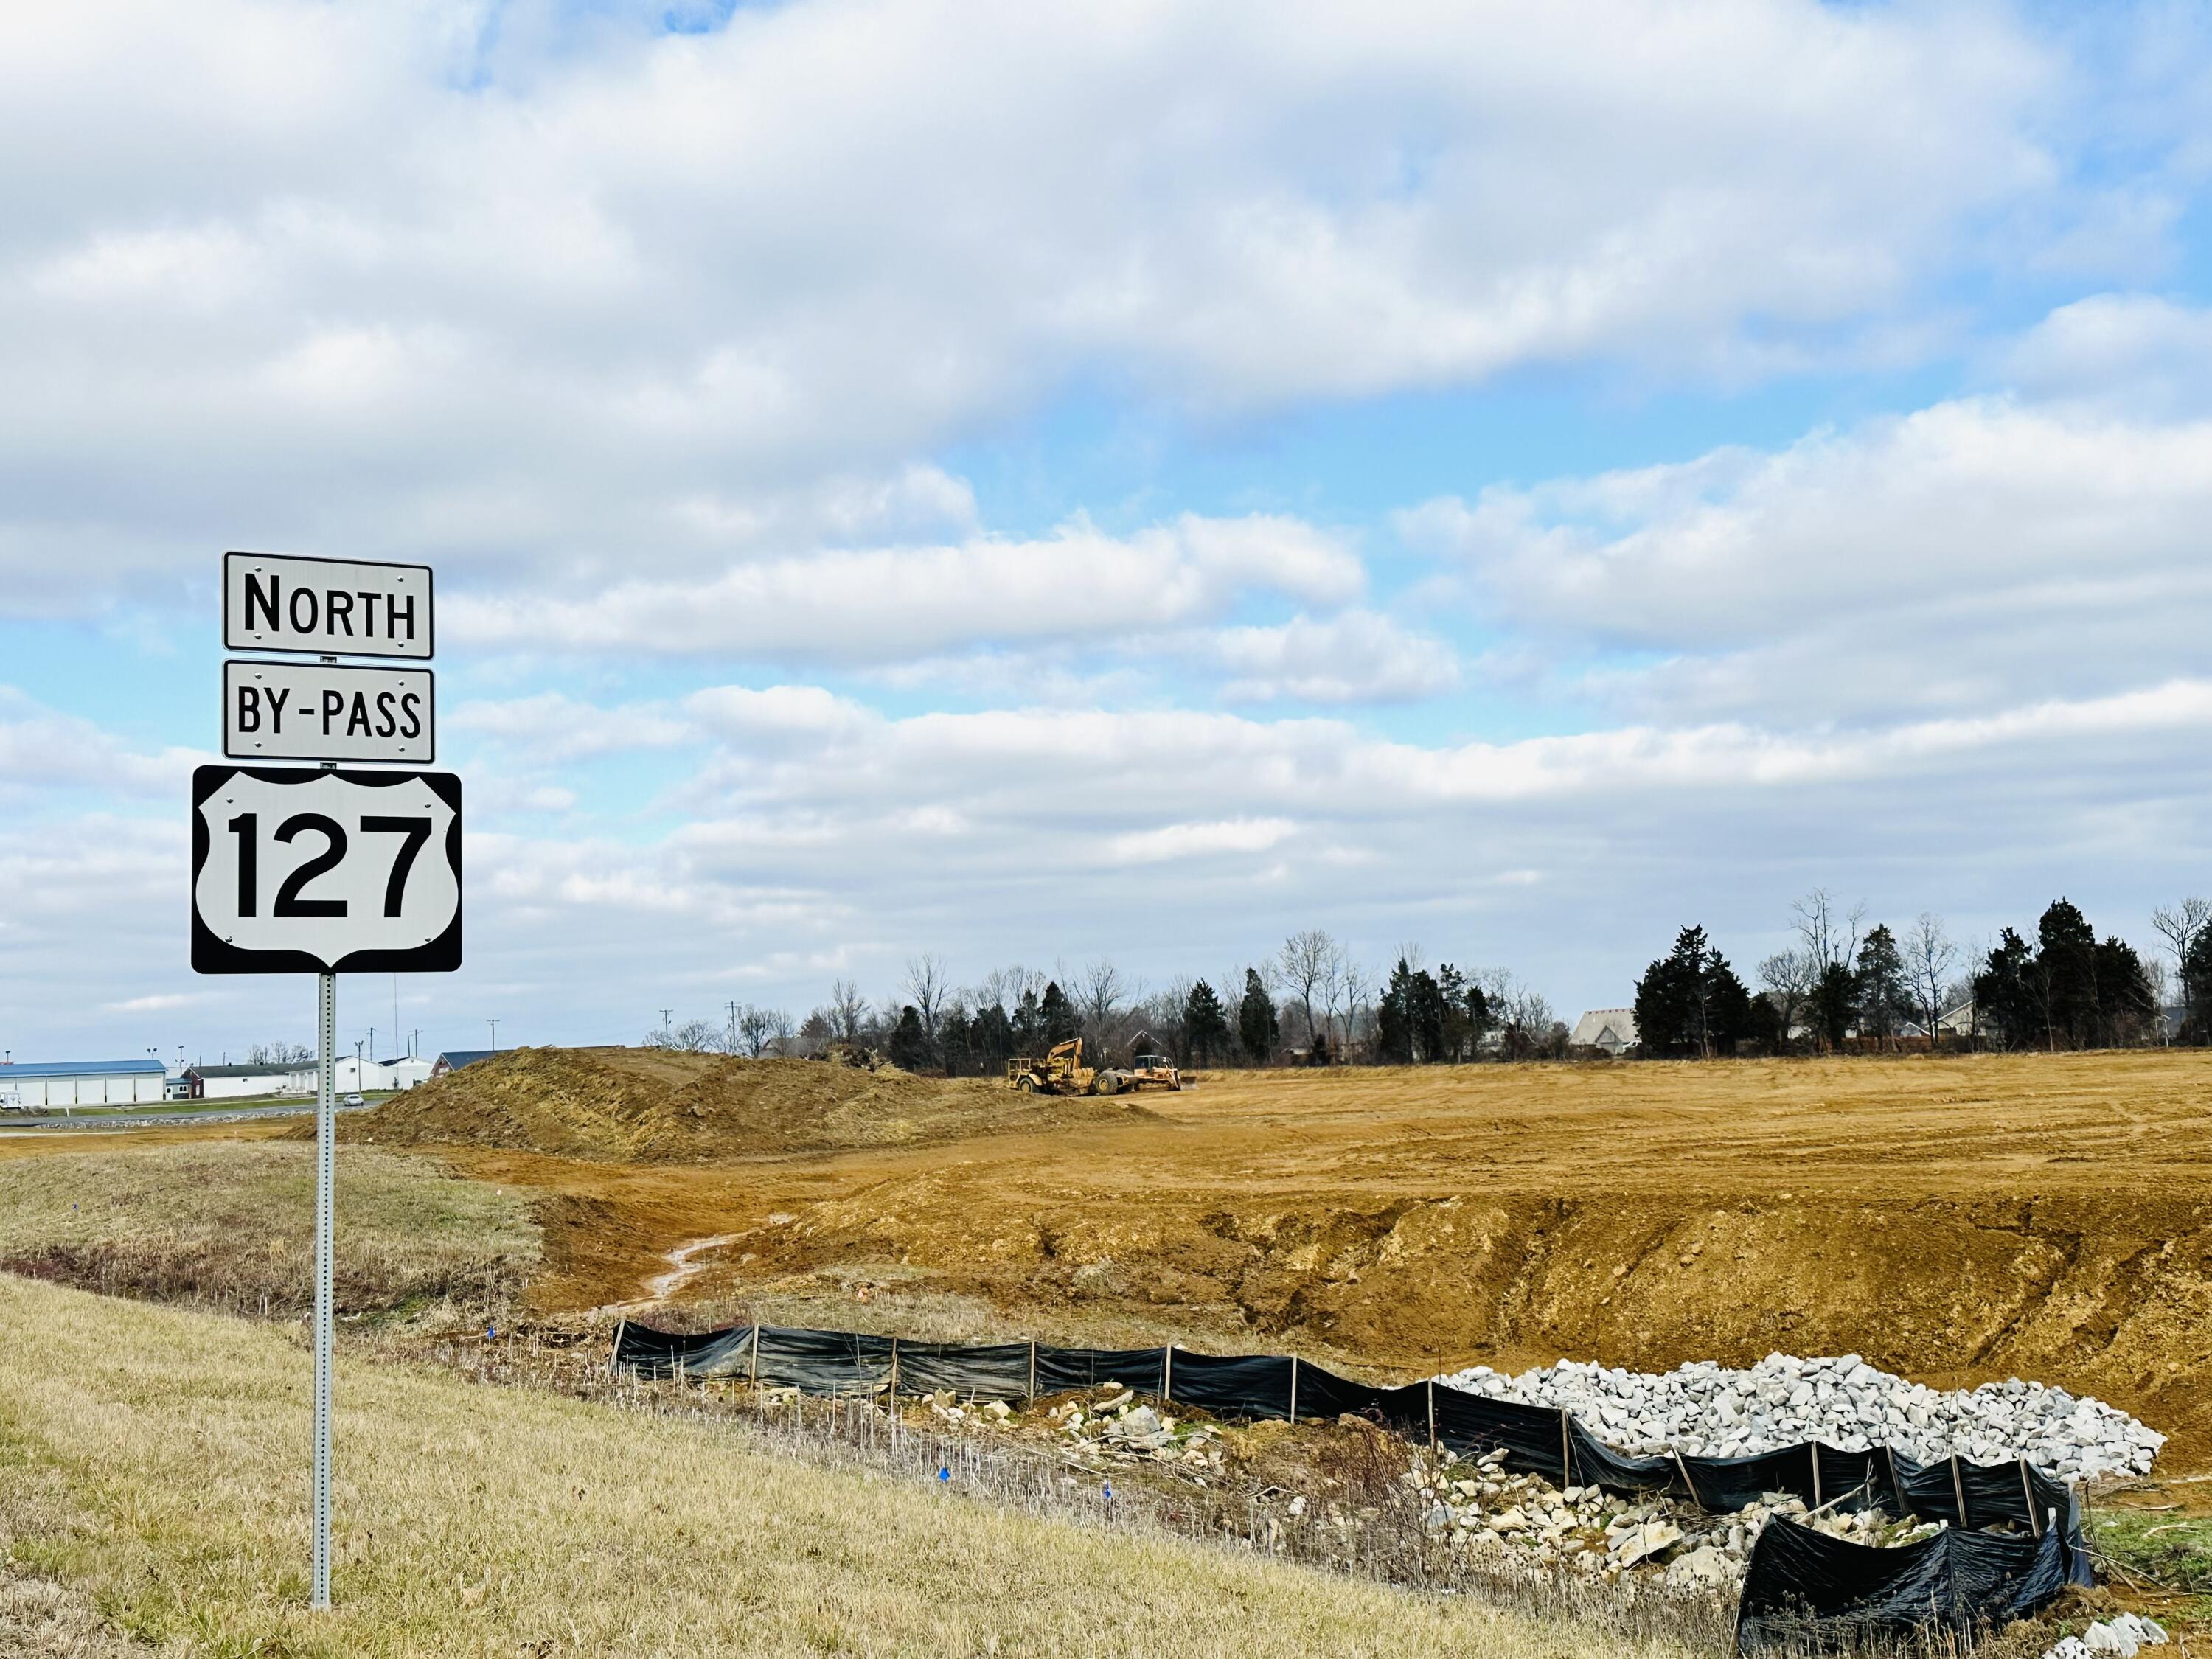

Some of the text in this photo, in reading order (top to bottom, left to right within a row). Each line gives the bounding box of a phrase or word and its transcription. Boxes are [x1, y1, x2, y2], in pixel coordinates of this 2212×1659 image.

[244, 573, 414, 640] NORTH
[238, 686, 421, 739] BY-PASS
[228, 813, 432, 918] 127
